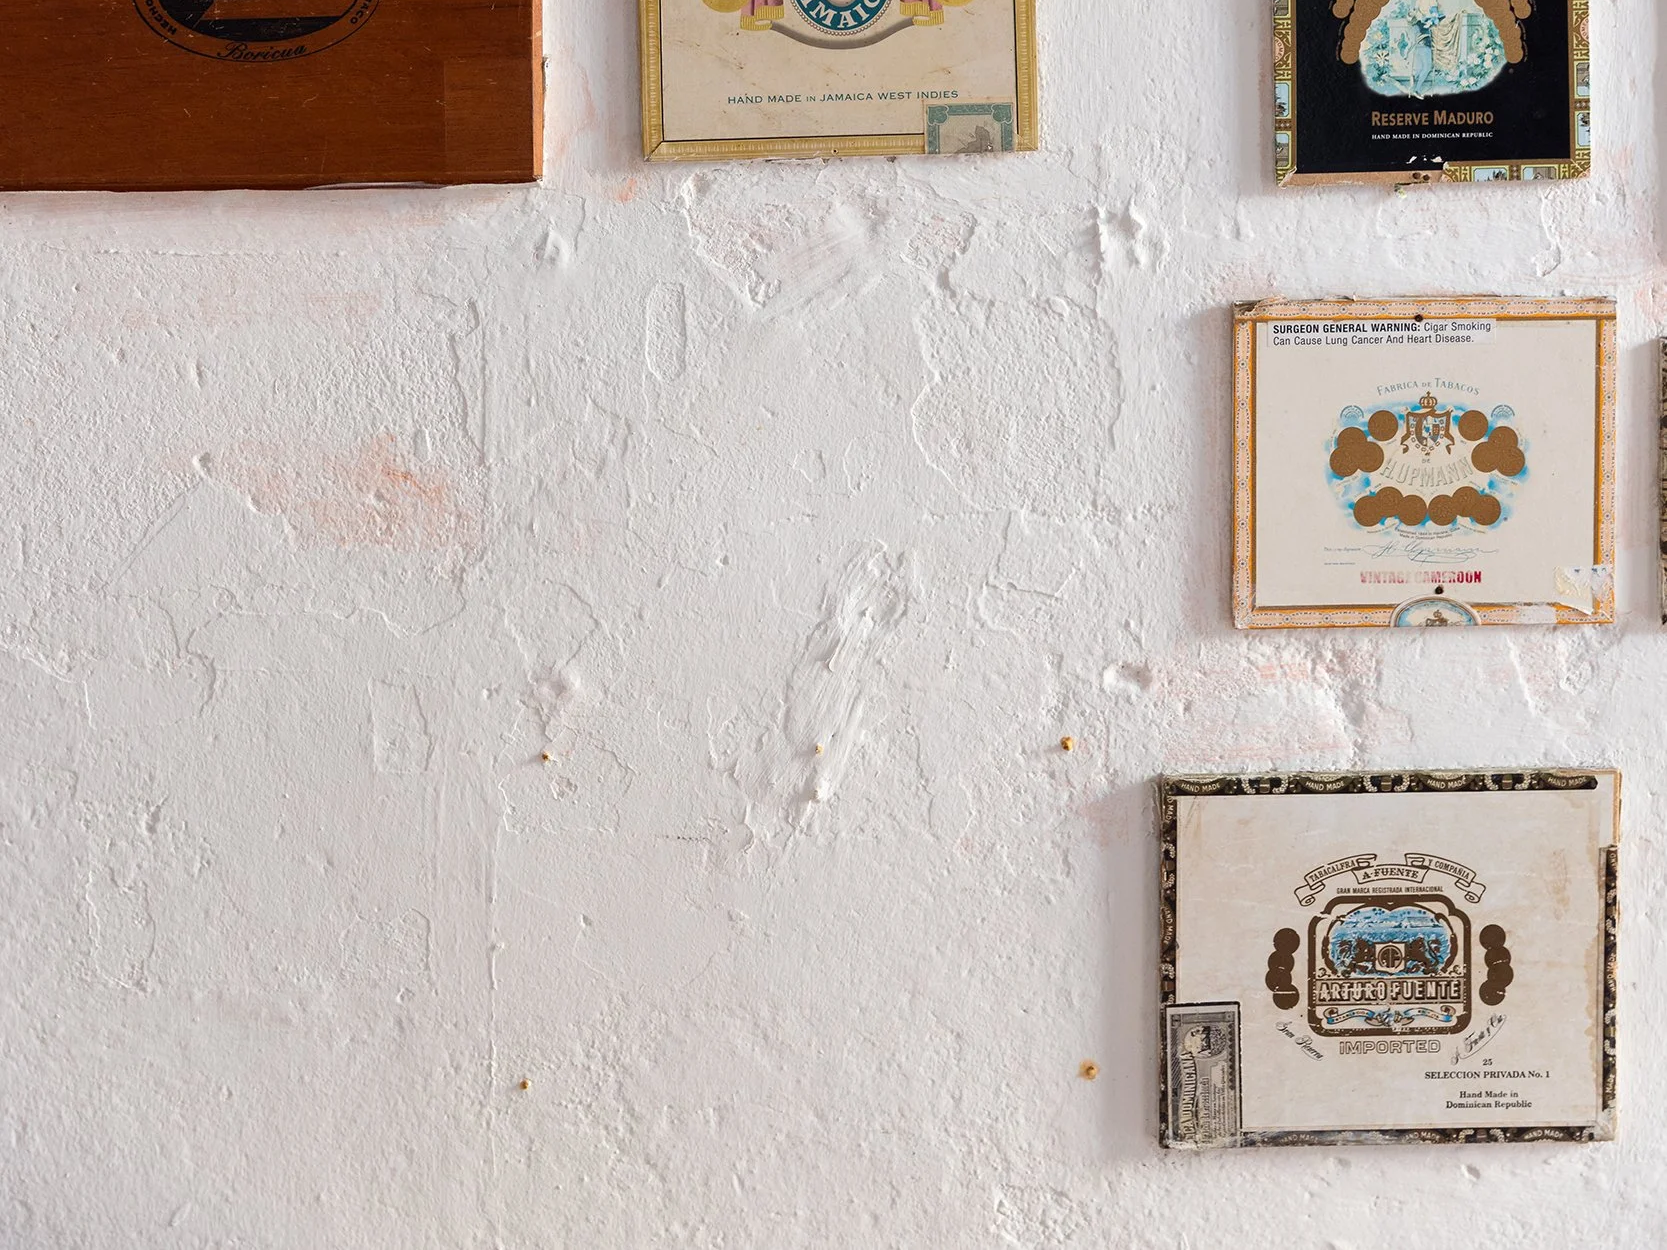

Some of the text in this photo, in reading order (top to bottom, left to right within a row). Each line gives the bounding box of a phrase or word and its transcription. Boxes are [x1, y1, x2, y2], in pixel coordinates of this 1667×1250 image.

[145, 0, 178, 35] HECHO
[216, 42, 307, 61] Boricua
[727, 90, 959, 105] HAND MADE IN JAMAICA WEST INDIES
[1273, 321, 1491, 334] SURGEON GENERAL WARNING: Cigar Smoking
[1273, 333, 1474, 347] Can Cause Lung Cancer And Heart Disease.
[1181, 783, 1221, 793] HAND MADE
[1305, 781, 1346, 791] HAND MADE
[1426, 778, 1467, 789] HAND MADE
[1548, 777, 1587, 787] HAND MADE
[1319, 980, 1461, 1001] ARTURO FUENTE
[1339, 1039, 1440, 1055] IMPORTED
[1425, 1070, 1550, 1079] SELECCION PRIVADA No. 1
[1510, 1090, 1518, 1098] in
[1446, 1100, 1532, 1109] Dominican Republic
